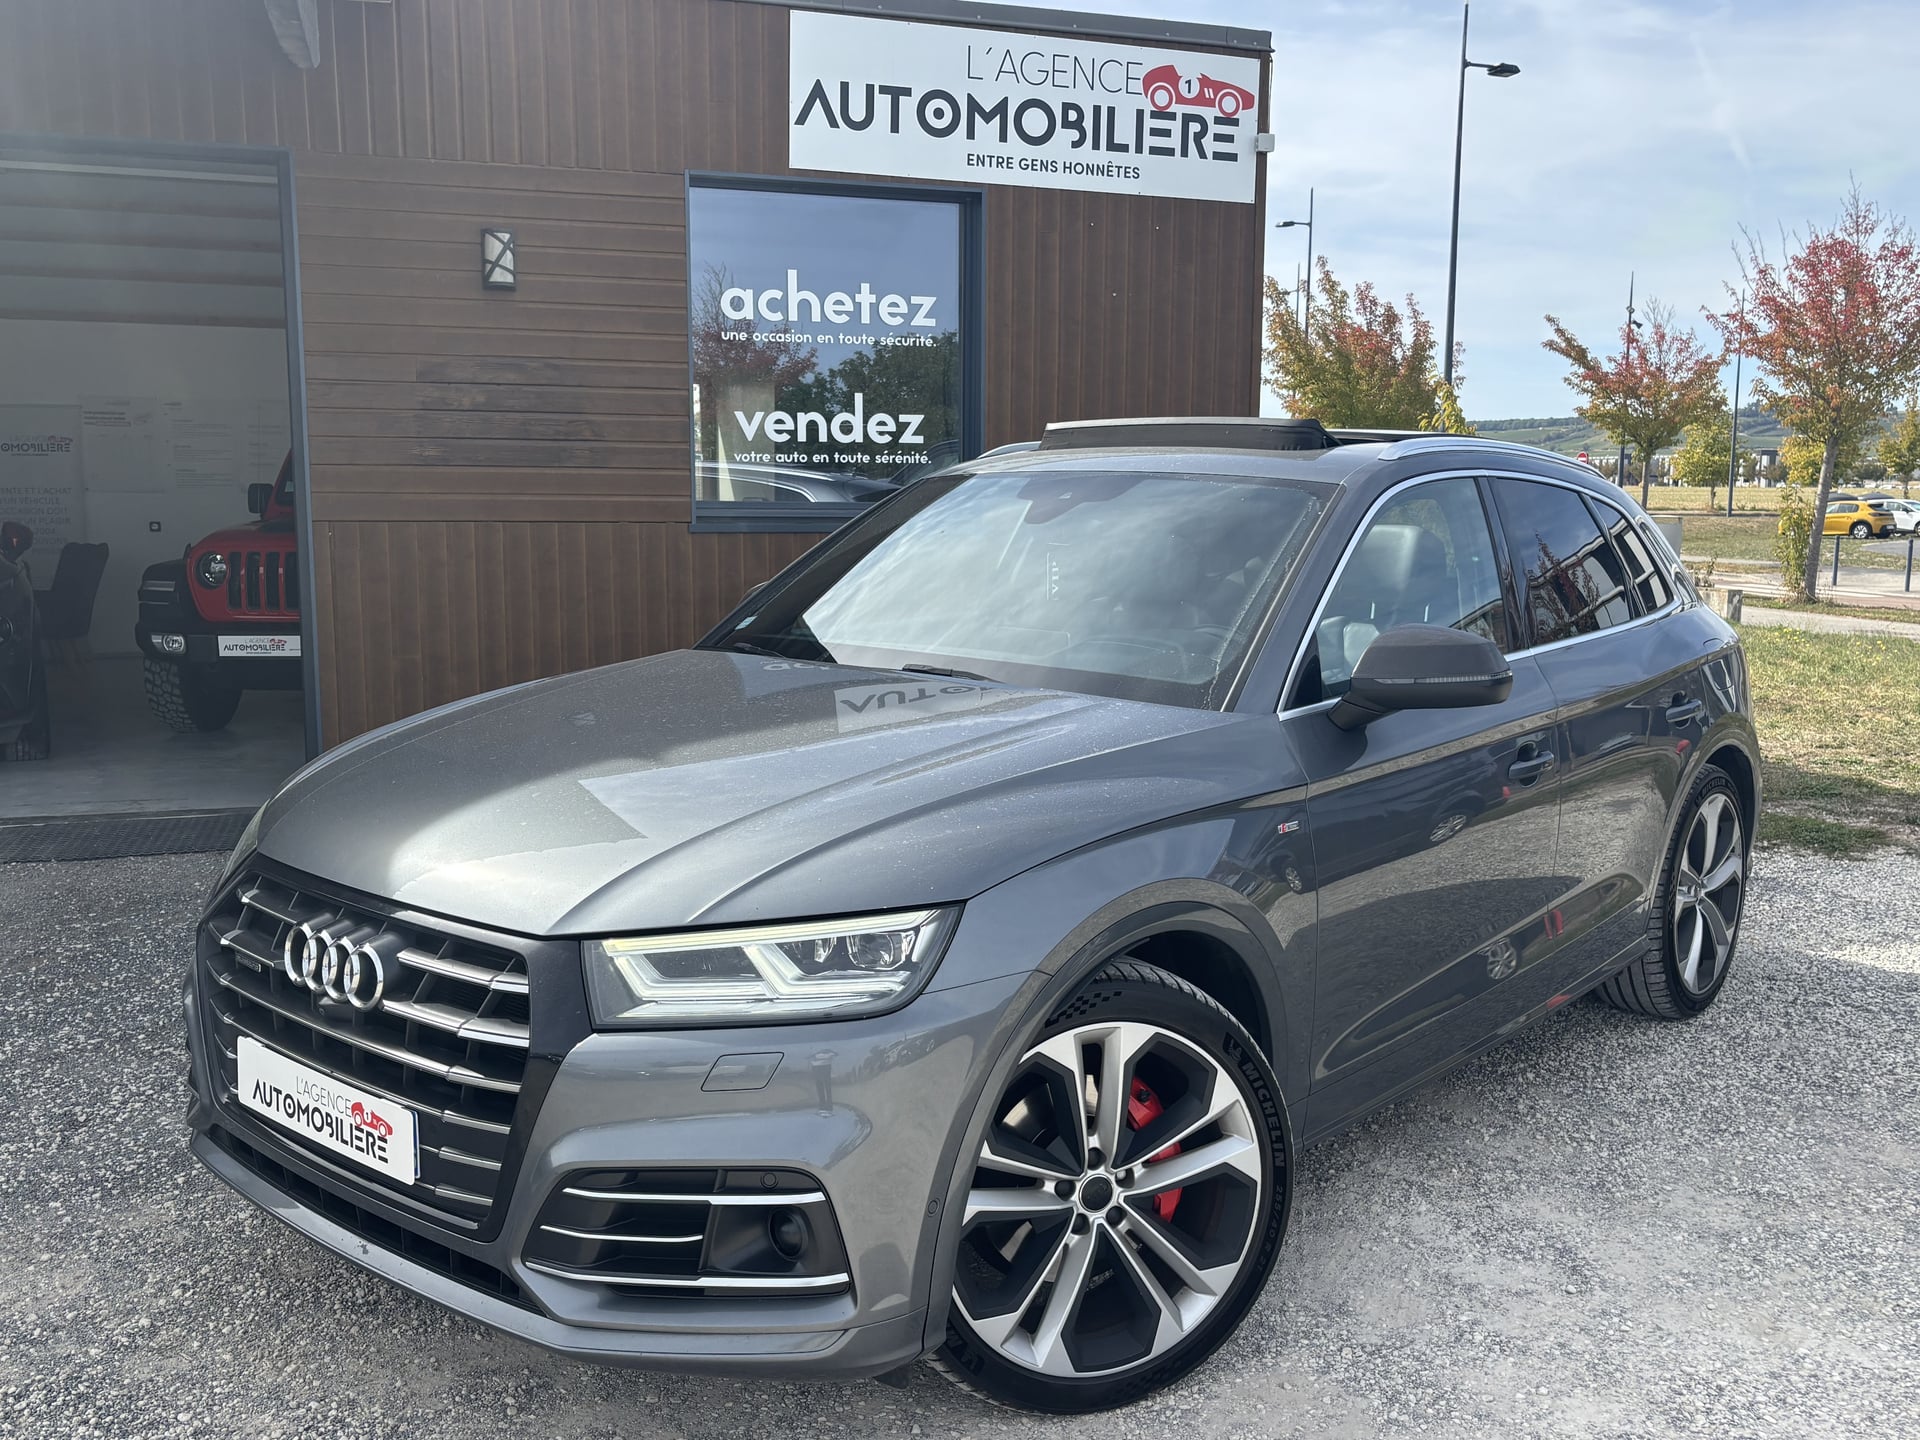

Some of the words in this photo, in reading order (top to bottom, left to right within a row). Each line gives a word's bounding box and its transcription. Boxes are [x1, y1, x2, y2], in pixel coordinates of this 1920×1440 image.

[793, 78, 1240, 163] AUTOMOBILIERE
[967, 153, 1014, 169] ENTRE
[1018, 157, 1058, 173] GENS
[1063, 160, 1140, 180] HONNÊTES
[720, 269, 937, 327] achetez
[721, 330, 748, 342] une
[752, 329, 812, 344] occasion
[817, 333, 834, 344] en
[838, 332, 876, 346] toute
[880, 331, 937, 347] sécurité.
[734, 393, 925, 444] vendez
[734, 451, 771, 464] votre
[775, 451, 808, 464] auto
[812, 453, 829, 464] en
[834, 451, 871, 465] toute
[875, 450, 932, 465] sérénité.
[252, 1078, 389, 1164] AUTOMOBILIERE
[296, 1076, 352, 1118] L'AGENCE
[1241, 1062, 1286, 1168] MICHELIN
